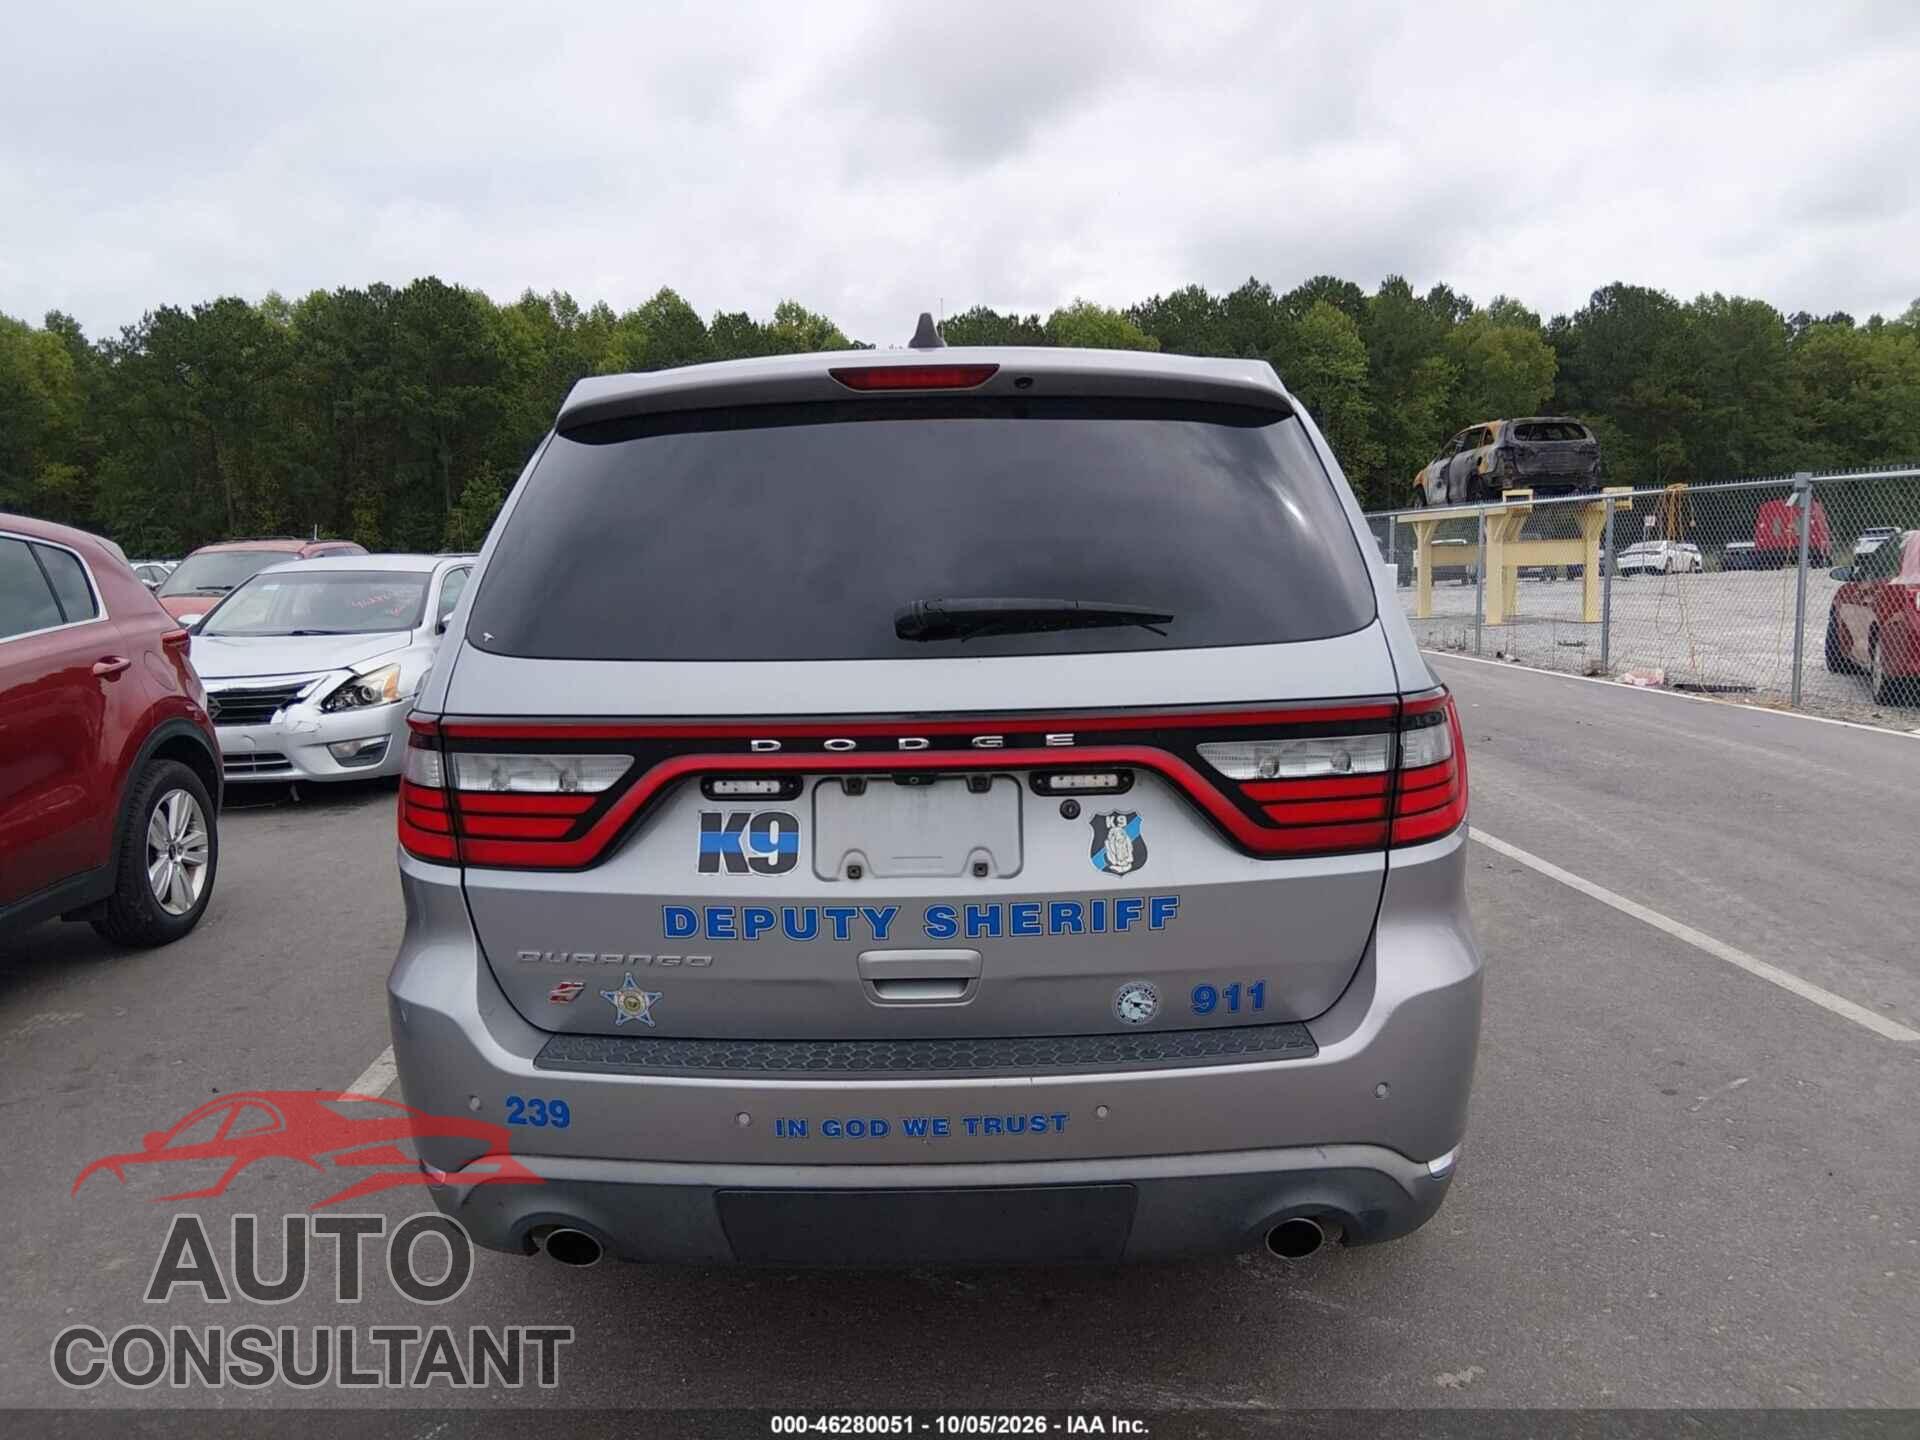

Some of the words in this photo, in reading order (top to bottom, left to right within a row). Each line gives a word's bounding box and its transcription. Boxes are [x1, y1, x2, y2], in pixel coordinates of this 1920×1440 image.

[751, 733, 1074, 751] DODGE
[1105, 814, 1127, 828] K9
[699, 810, 800, 876] K9
[662, 904, 899, 940] DEPUTY
[922, 895, 1180, 940] SHERIFF
[516, 951, 713, 967] DURANGO
[1191, 981, 1267, 1016] 911
[505, 1096, 571, 1128] 239
[775, 1118, 809, 1138] IN
[821, 1118, 890, 1138] GOD
[902, 1117, 950, 1137] WE
[962, 1112, 1070, 1136] TRUST
